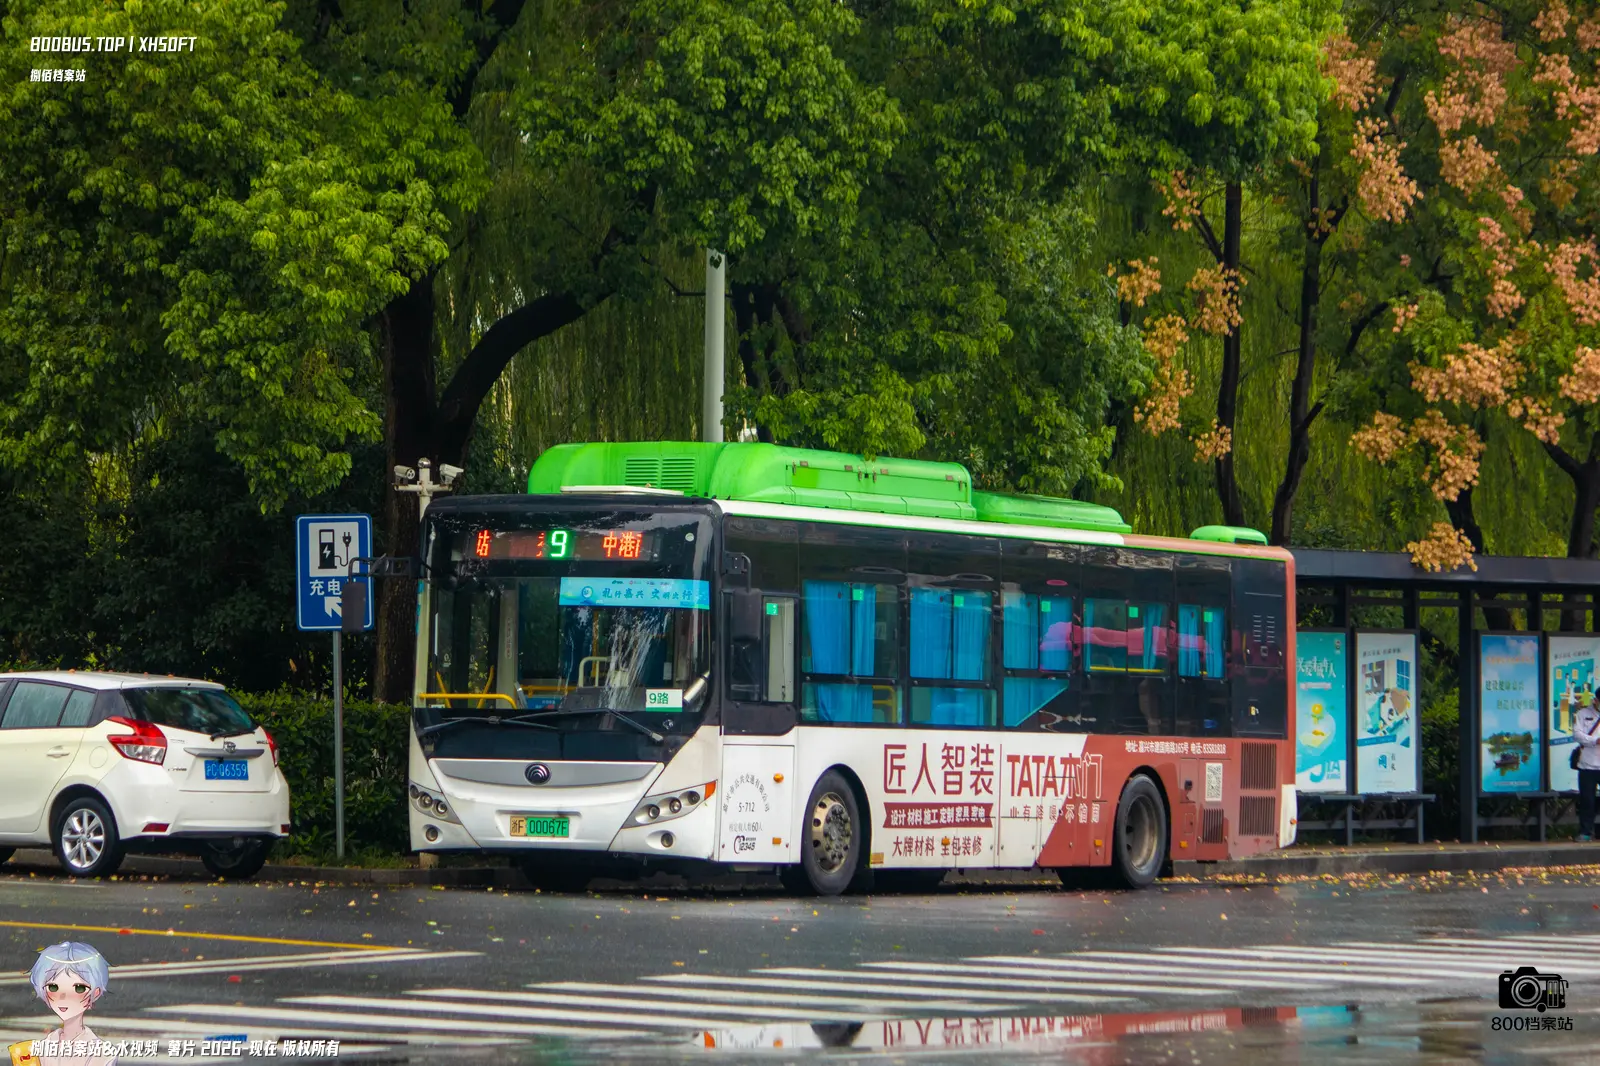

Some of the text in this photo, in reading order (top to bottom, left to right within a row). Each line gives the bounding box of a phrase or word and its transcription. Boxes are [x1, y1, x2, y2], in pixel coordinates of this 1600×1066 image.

[550, 530, 568, 558] 9
[649, 692, 669, 705] 9路
[883, 742, 995, 796] 匠人智装
[1006, 752, 1103, 799] TATA木门
[892, 835, 935, 857] 大牌材料
